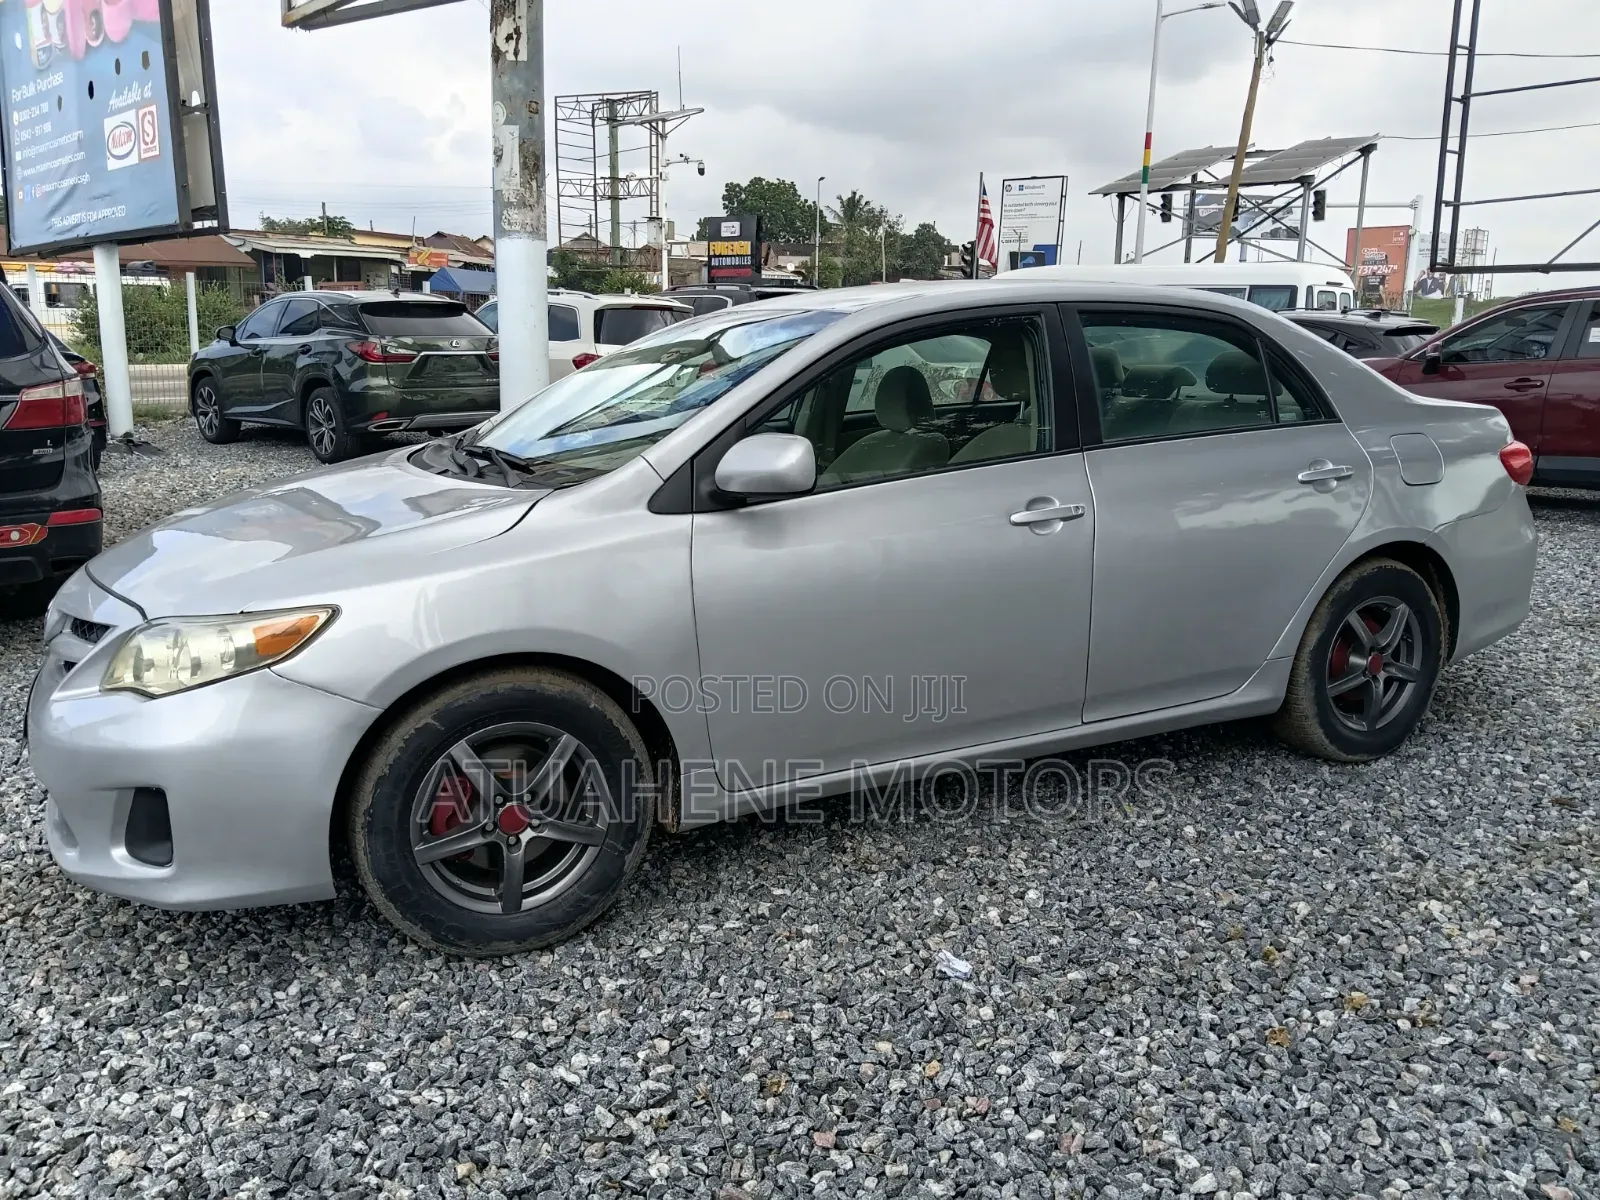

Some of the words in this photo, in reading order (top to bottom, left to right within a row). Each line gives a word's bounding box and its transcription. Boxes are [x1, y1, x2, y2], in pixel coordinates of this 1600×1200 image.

[12, 89, 22, 103] For
[22, 81, 37, 98] Bulk
[37, 71, 64, 93] Purchase
[108, 81, 141, 112] Available
[143, 80, 152, 98] at
[52, 215, 63, 227] THIS
[62, 213, 81, 226] ADVERT
[98, 205, 126, 220] APPROVED
[712, 256, 751, 265] AUTOMOBILES
